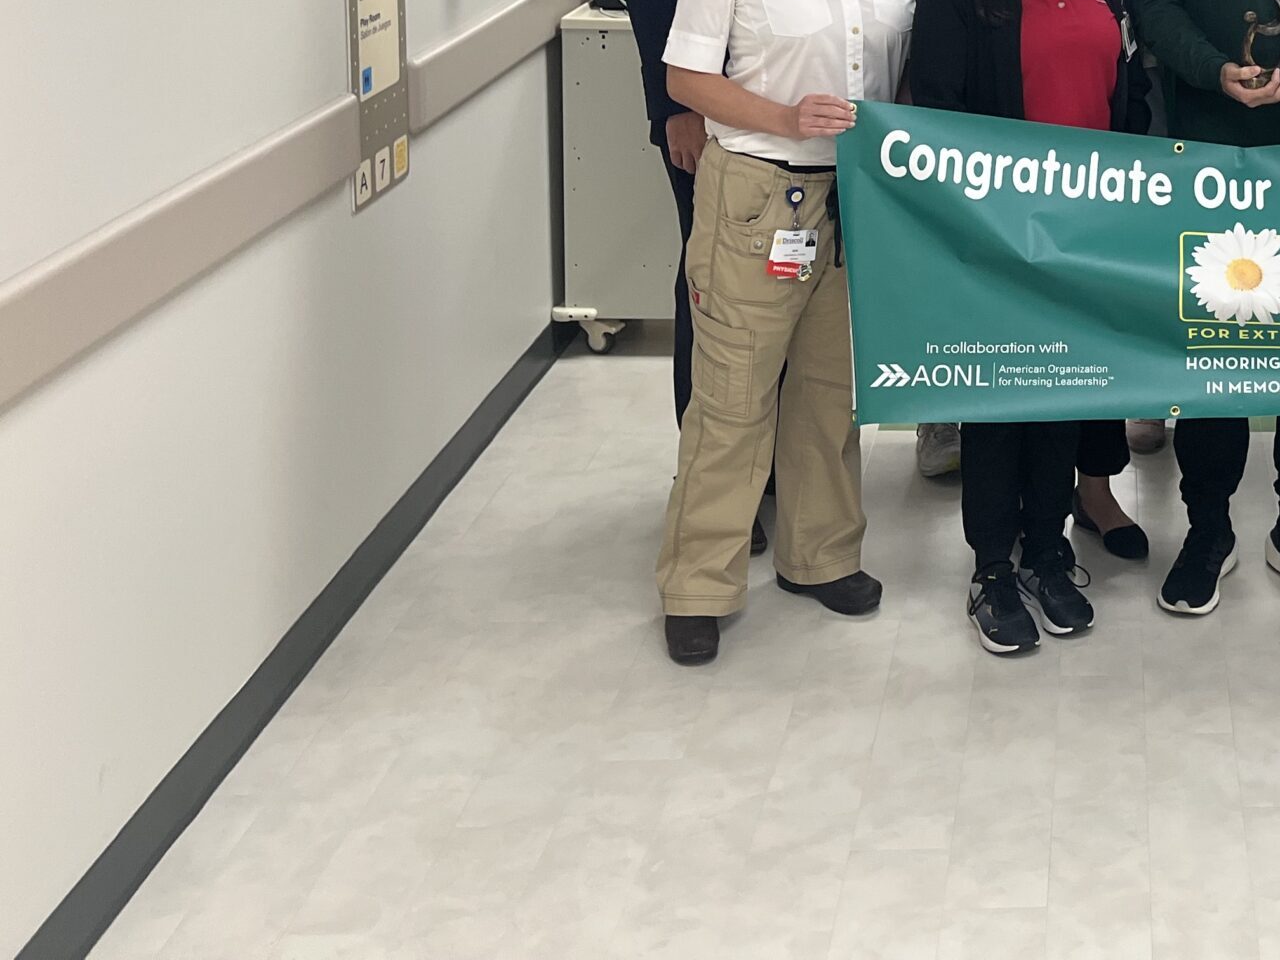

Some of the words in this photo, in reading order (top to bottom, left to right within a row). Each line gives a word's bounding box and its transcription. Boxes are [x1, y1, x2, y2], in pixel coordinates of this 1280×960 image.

[880, 129, 1173, 206] Congratulate
[1194, 166, 1273, 210] Our
[360, 171, 368, 195] A
[1187, 327, 1230, 340] FOR
[926, 342, 939, 354] In
[943, 341, 1036, 354] collaboration
[1039, 341, 1068, 354] with
[1186, 356, 1280, 370] HONORING
[910, 364, 990, 387] AONL
[998, 364, 1045, 374] American
[1047, 364, 1108, 376] Organization
[998, 376, 1012, 387] for
[1014, 376, 1053, 389] Nursing
[1206, 381, 1224, 394] IN
